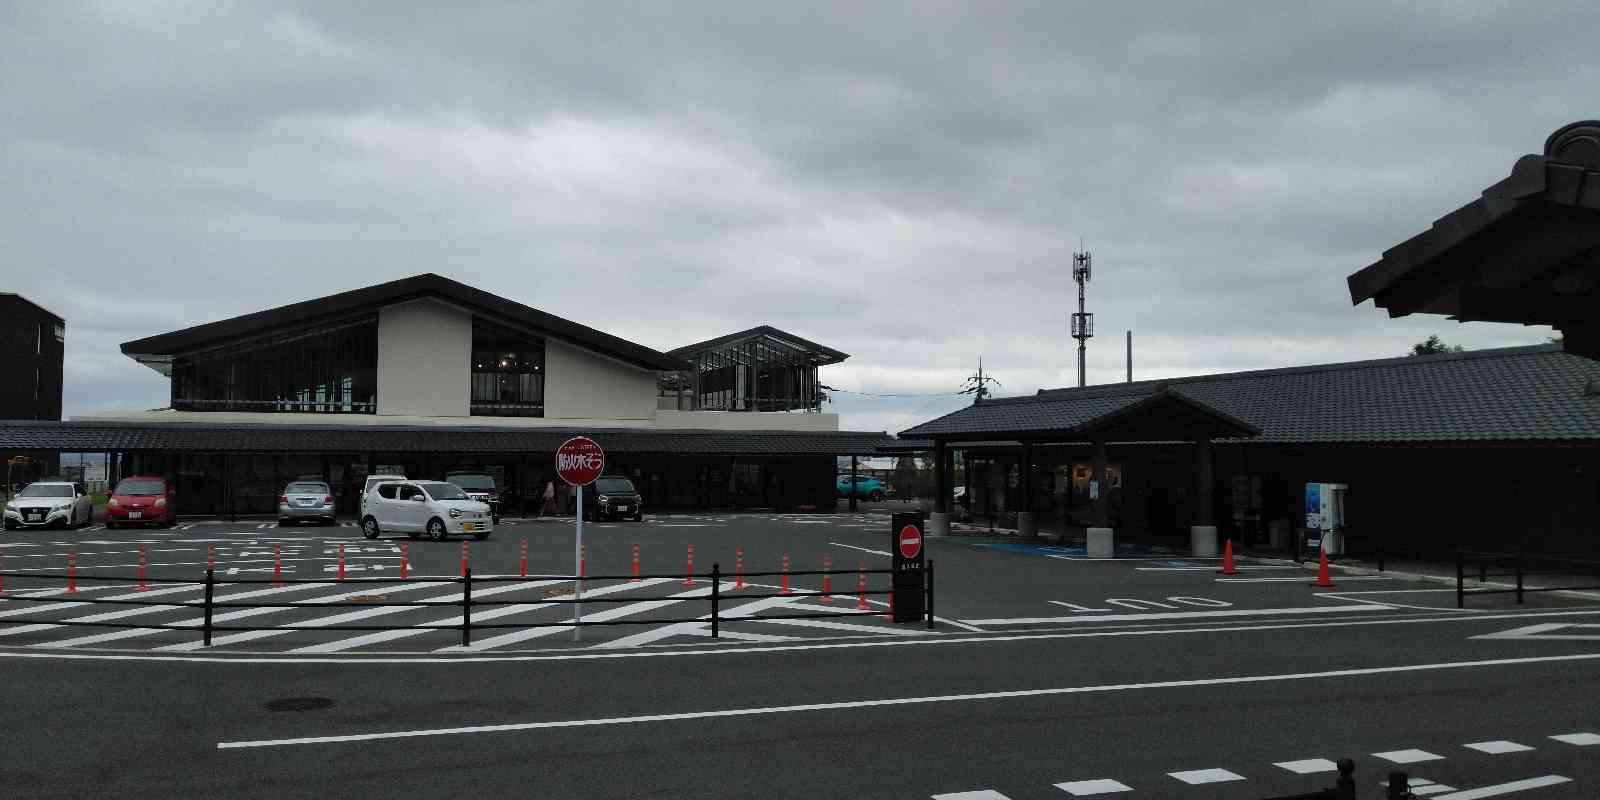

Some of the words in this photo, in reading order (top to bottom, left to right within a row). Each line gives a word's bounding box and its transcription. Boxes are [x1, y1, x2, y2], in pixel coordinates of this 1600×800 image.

[558, 453, 603, 471] 防火水そう
[1048, 597, 1233, 612] OUT
